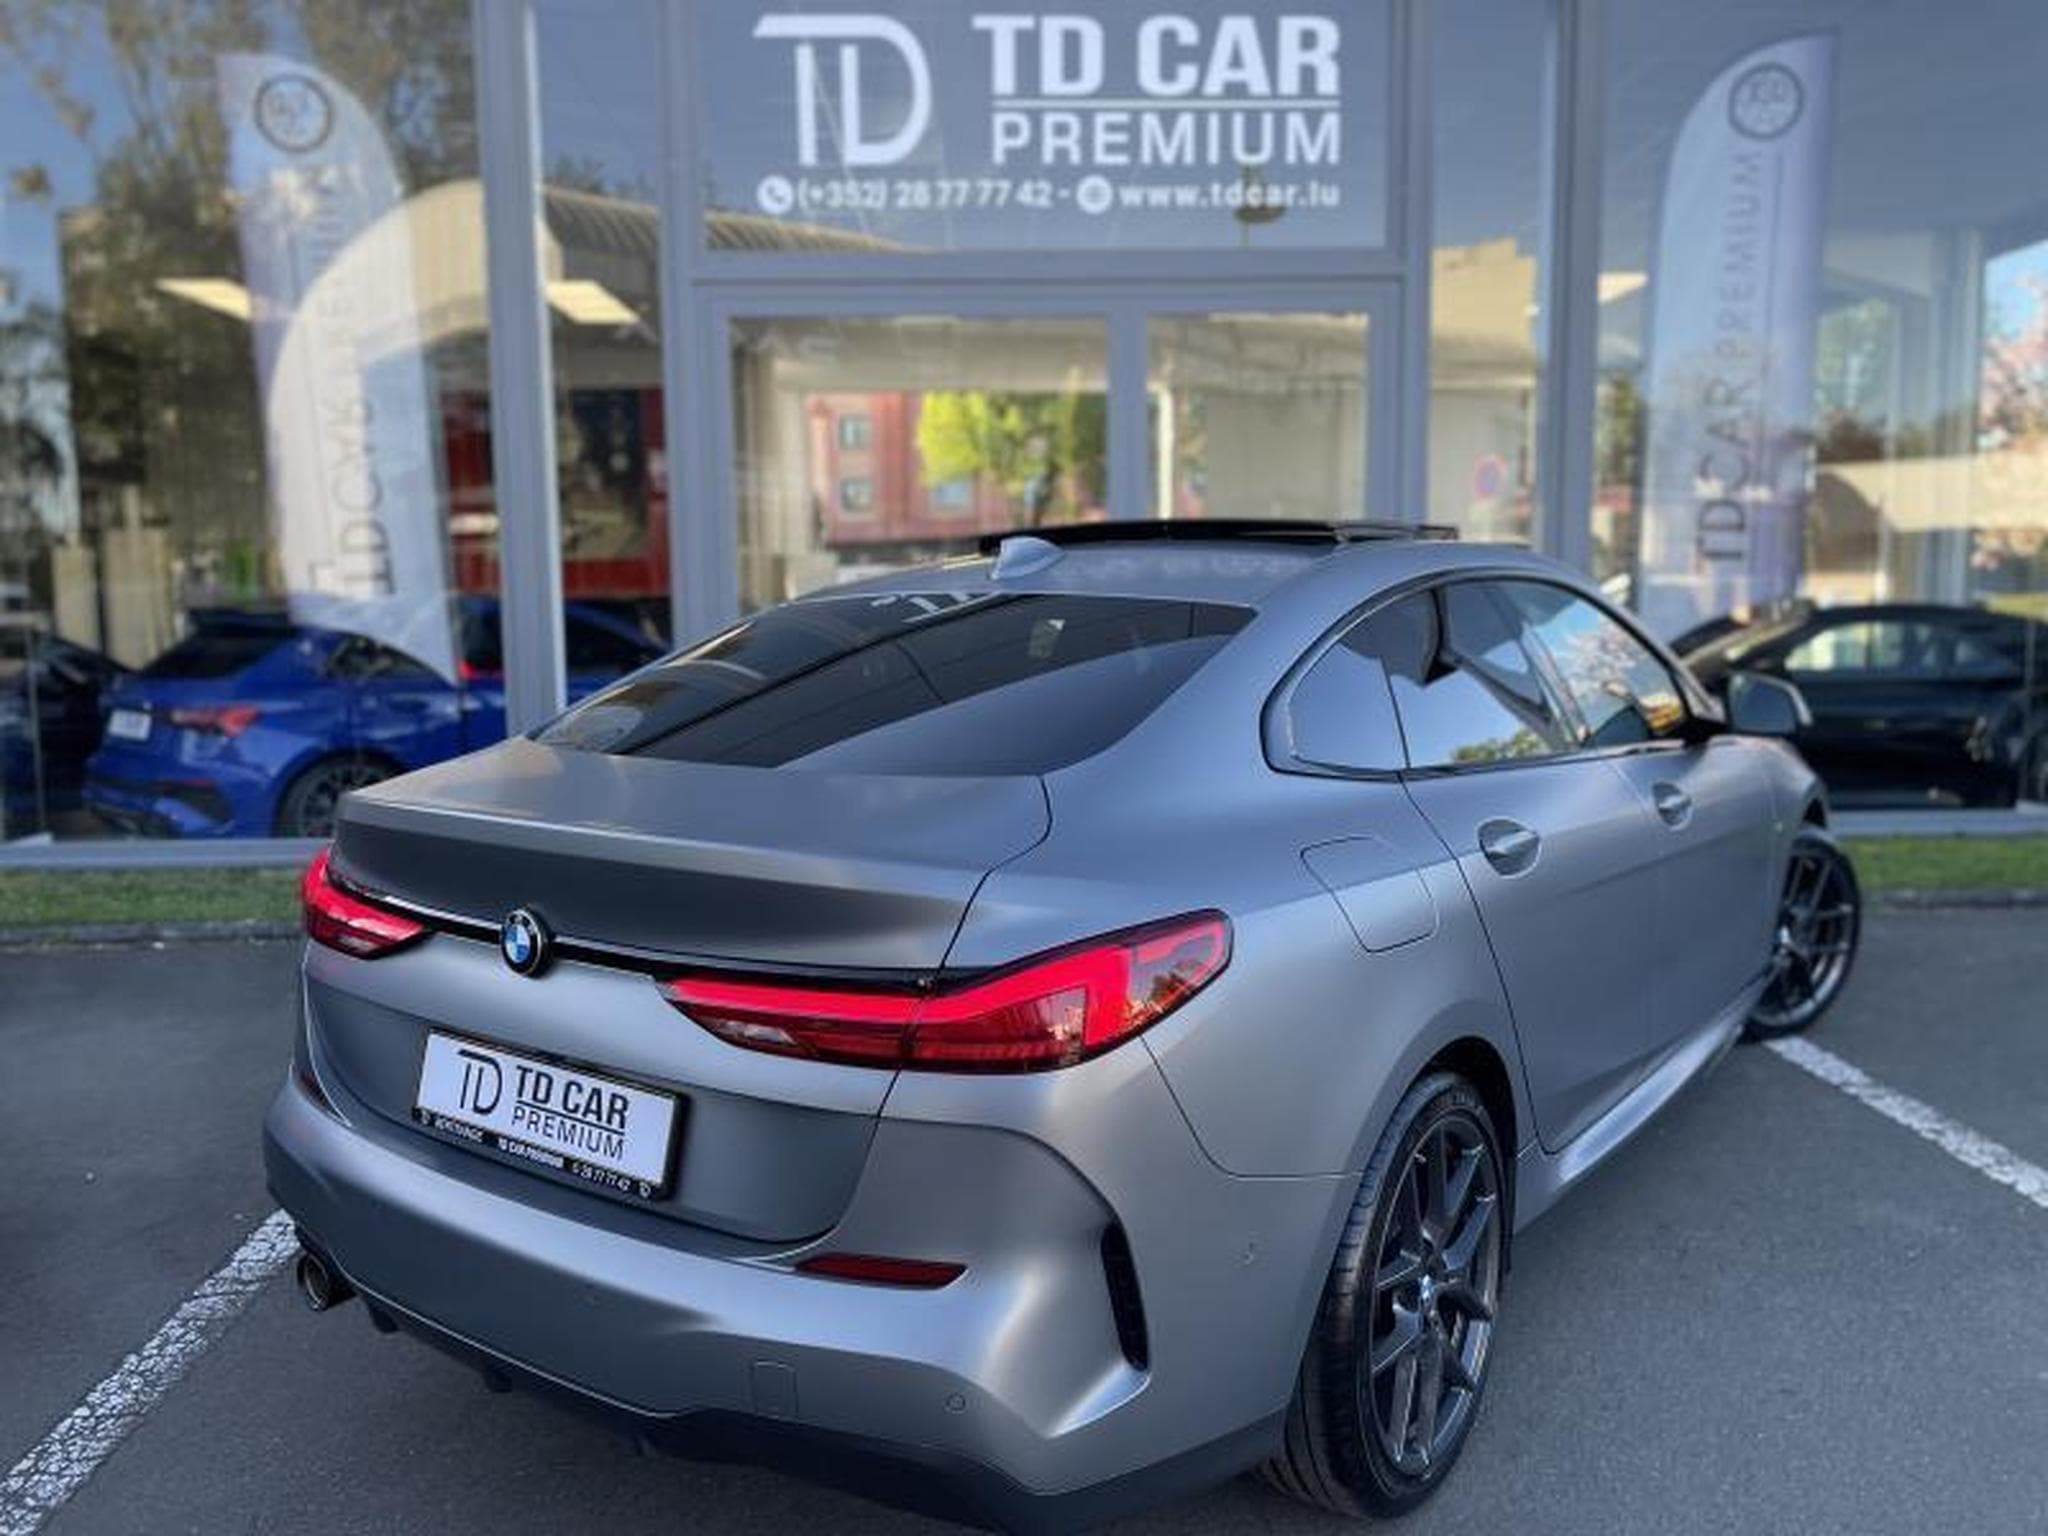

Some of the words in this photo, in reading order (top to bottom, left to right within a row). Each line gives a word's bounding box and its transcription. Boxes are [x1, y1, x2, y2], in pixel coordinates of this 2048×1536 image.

[971, 14, 1104, 97] TD
[1137, 14, 1341, 97] CAR
[991, 110, 1342, 166] PREMIUM
[1118, 180, 1341, 209] www.tdcar.lu
[1715, 153, 1764, 361] PREMIUM
[516, 1065, 554, 1105] TD
[561, 1080, 629, 1130] CAR
[511, 1105, 625, 1161] PREMIUM
